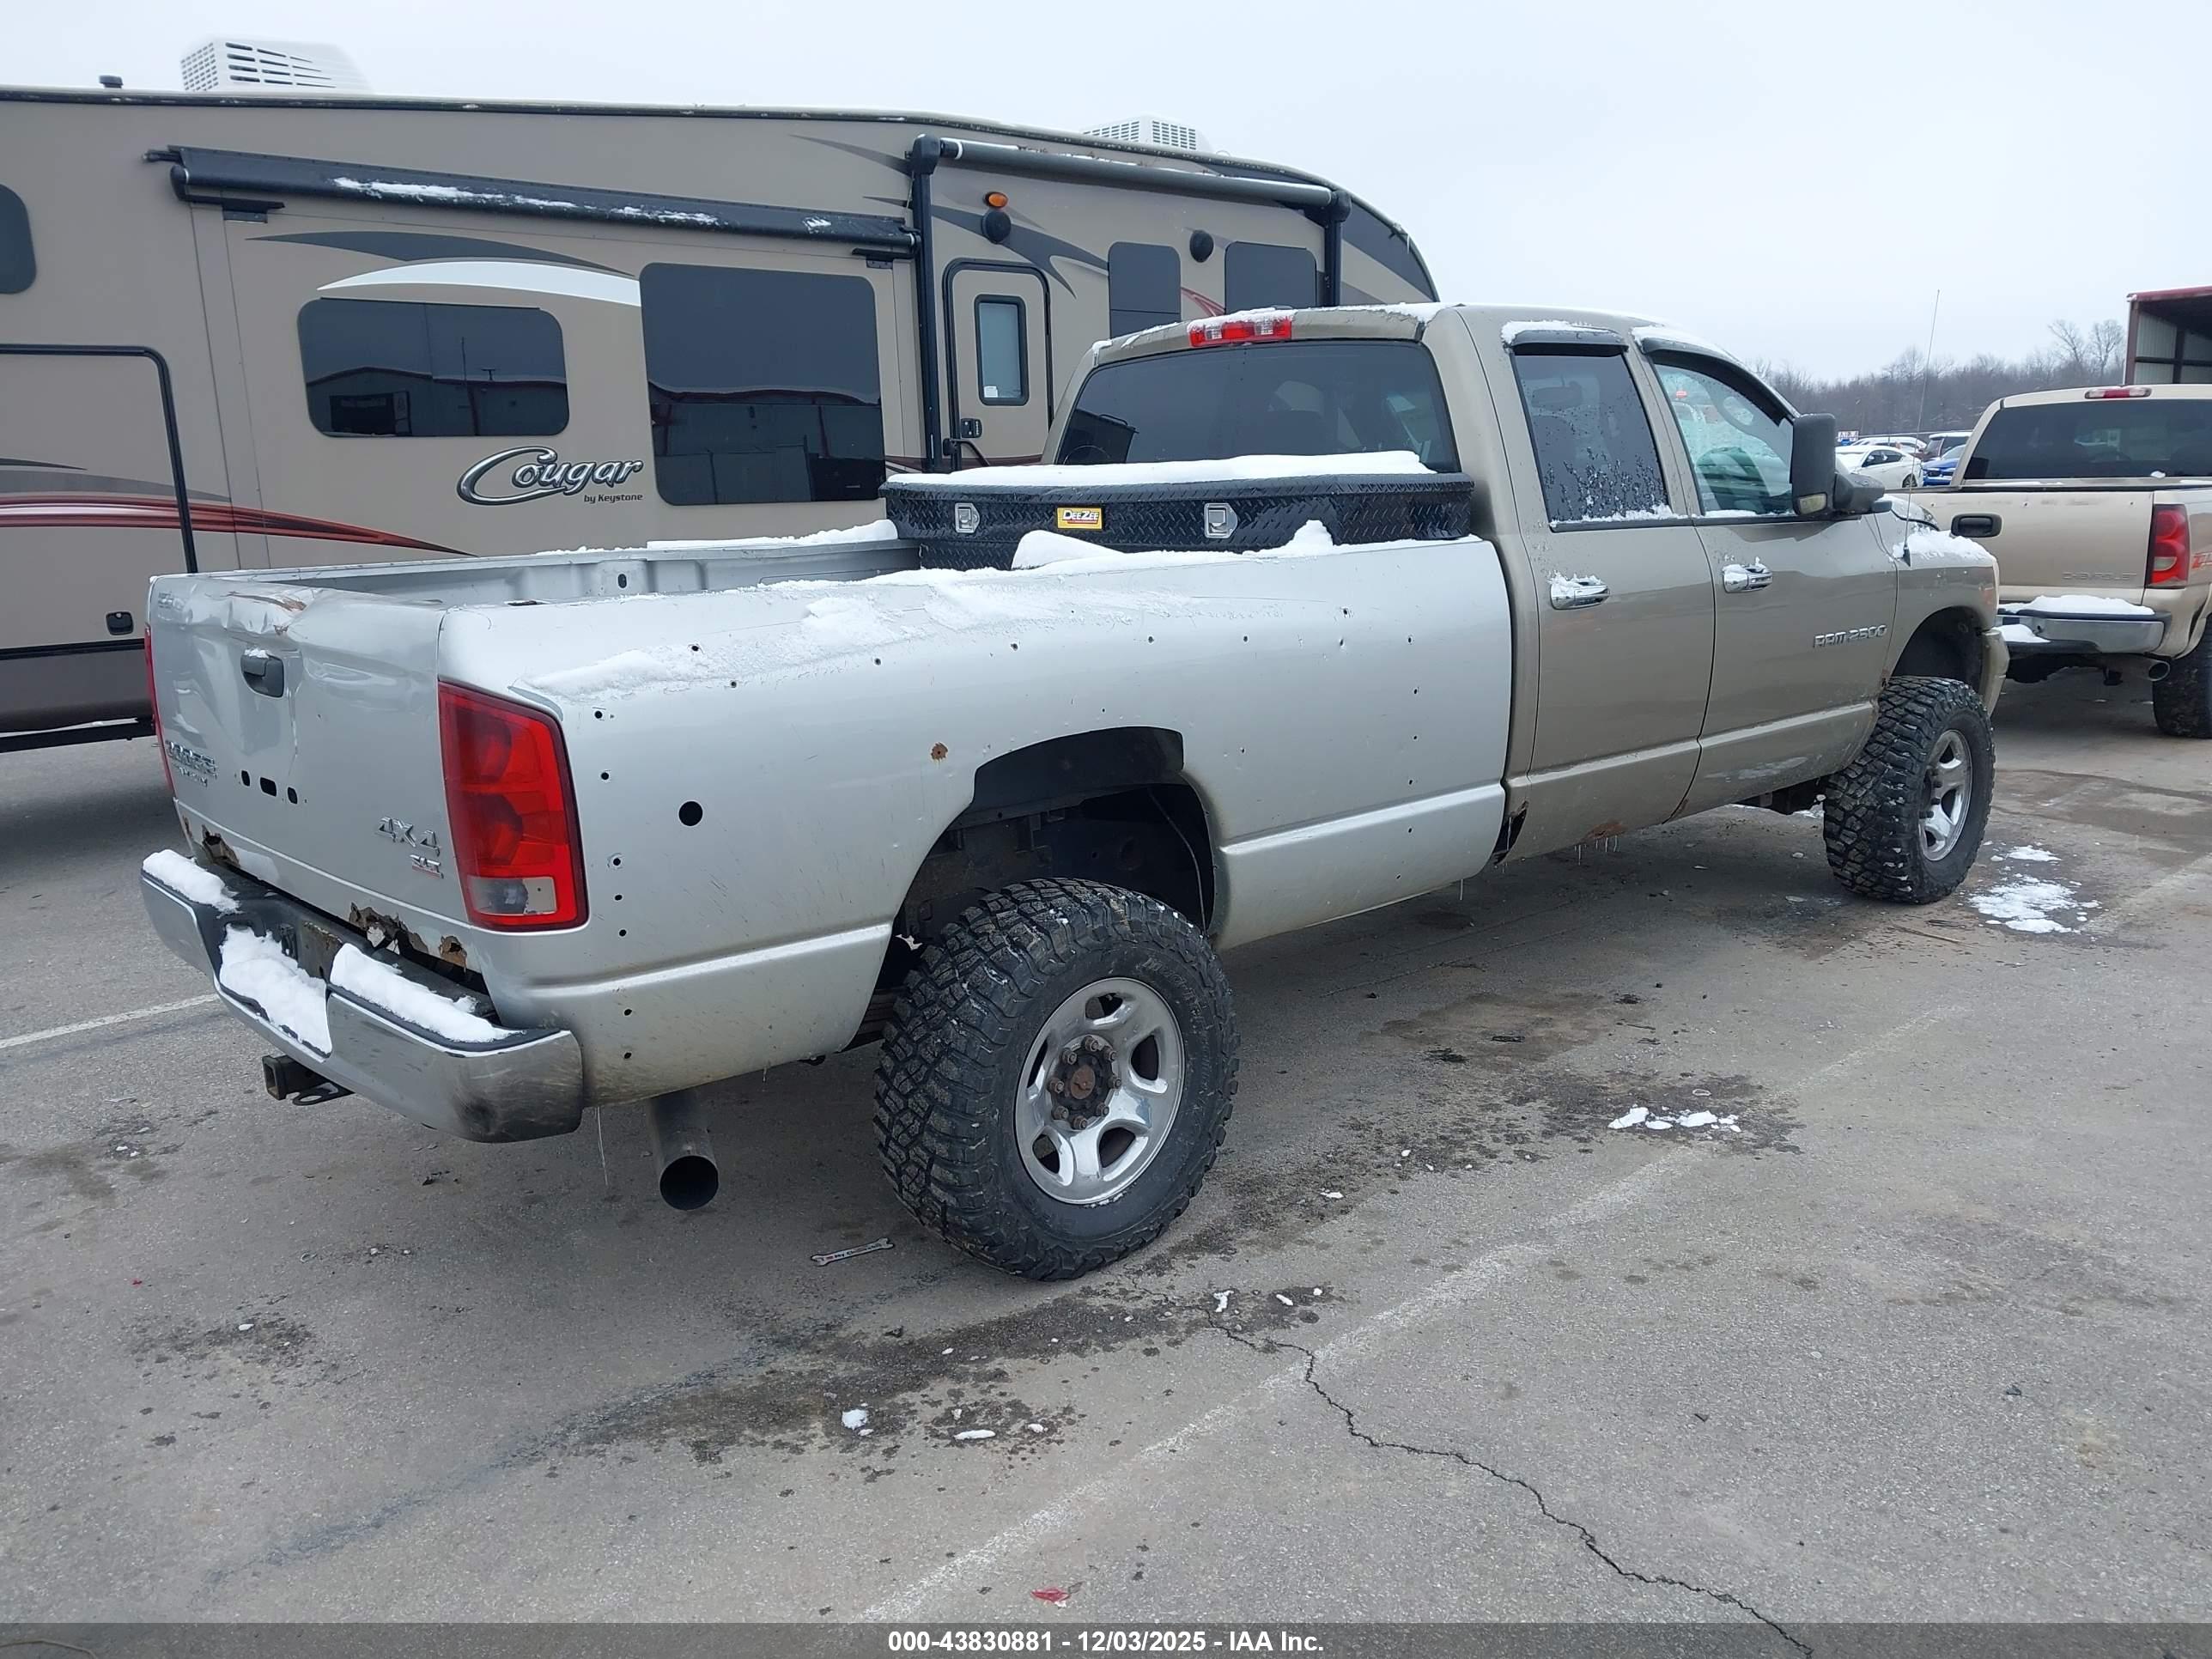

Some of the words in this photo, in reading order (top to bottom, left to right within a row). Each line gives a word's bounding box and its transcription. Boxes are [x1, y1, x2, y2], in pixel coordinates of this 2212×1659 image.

[456, 446, 644, 505] Cougar
[584, 495, 596, 503] by
[598, 494, 643, 503] Keystone
[2062, 571, 2137, 580] CHEVROLET
[1813, 632, 1846, 647] RAM
[1848, 624, 1887, 641] 2500
